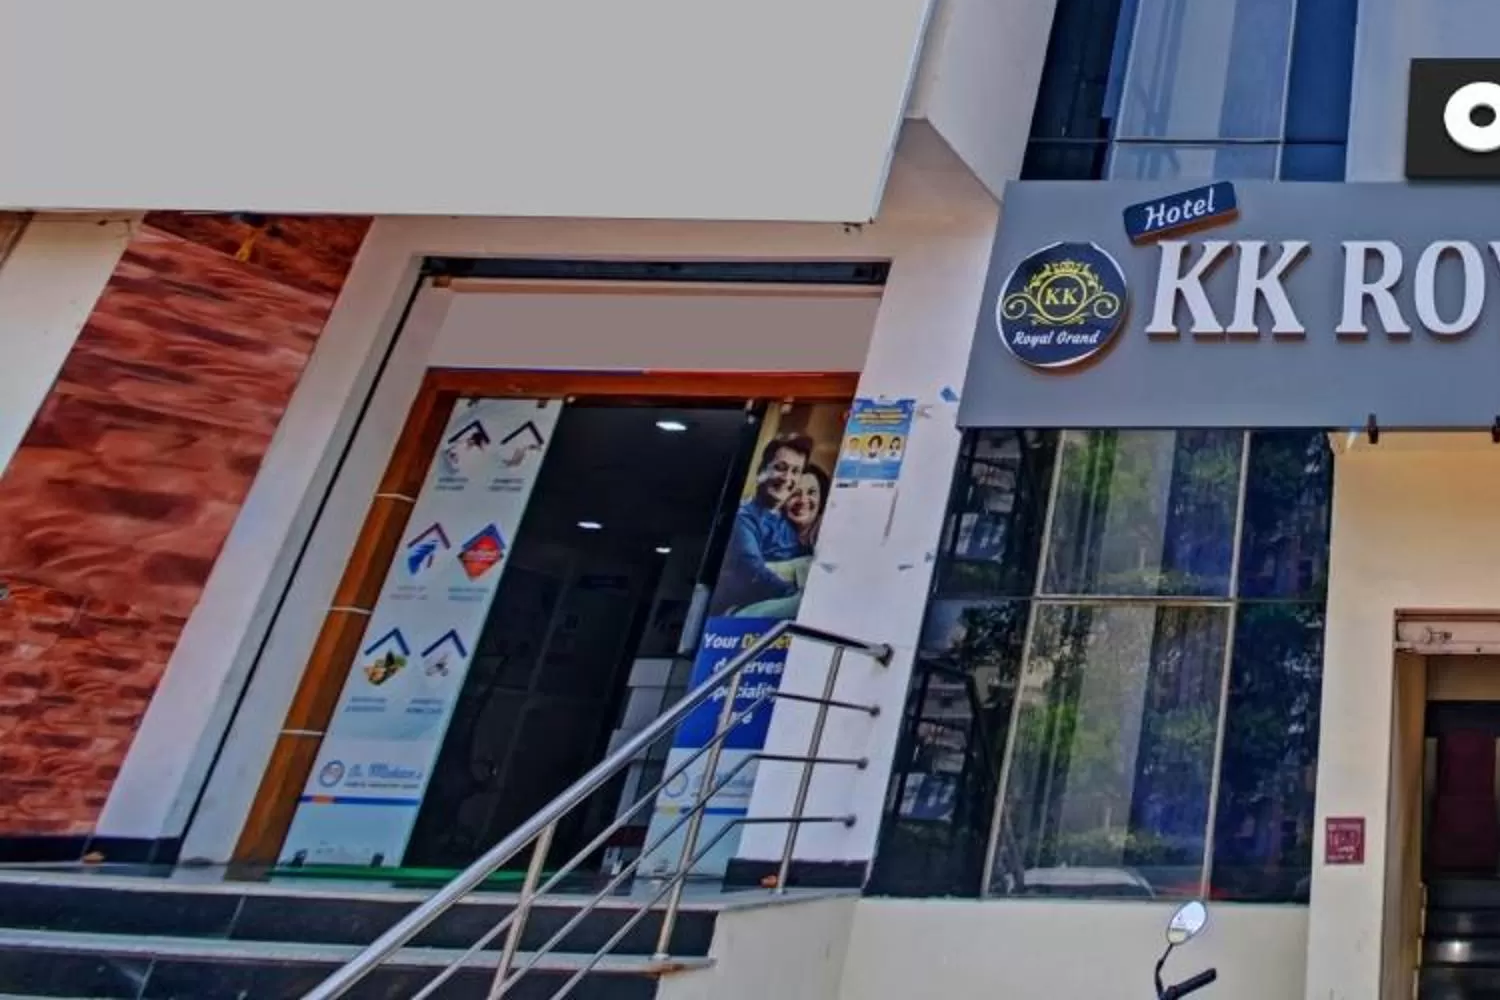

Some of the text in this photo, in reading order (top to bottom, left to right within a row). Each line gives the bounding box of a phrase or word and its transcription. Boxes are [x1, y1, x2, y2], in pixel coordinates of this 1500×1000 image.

[1144, 185, 1216, 231] Hotel
[1045, 287, 1078, 306] KK
[1145, 240, 1311, 337] KK
[1012, 329, 1101, 349] Royal Grand
[703, 632, 741, 649] Your
